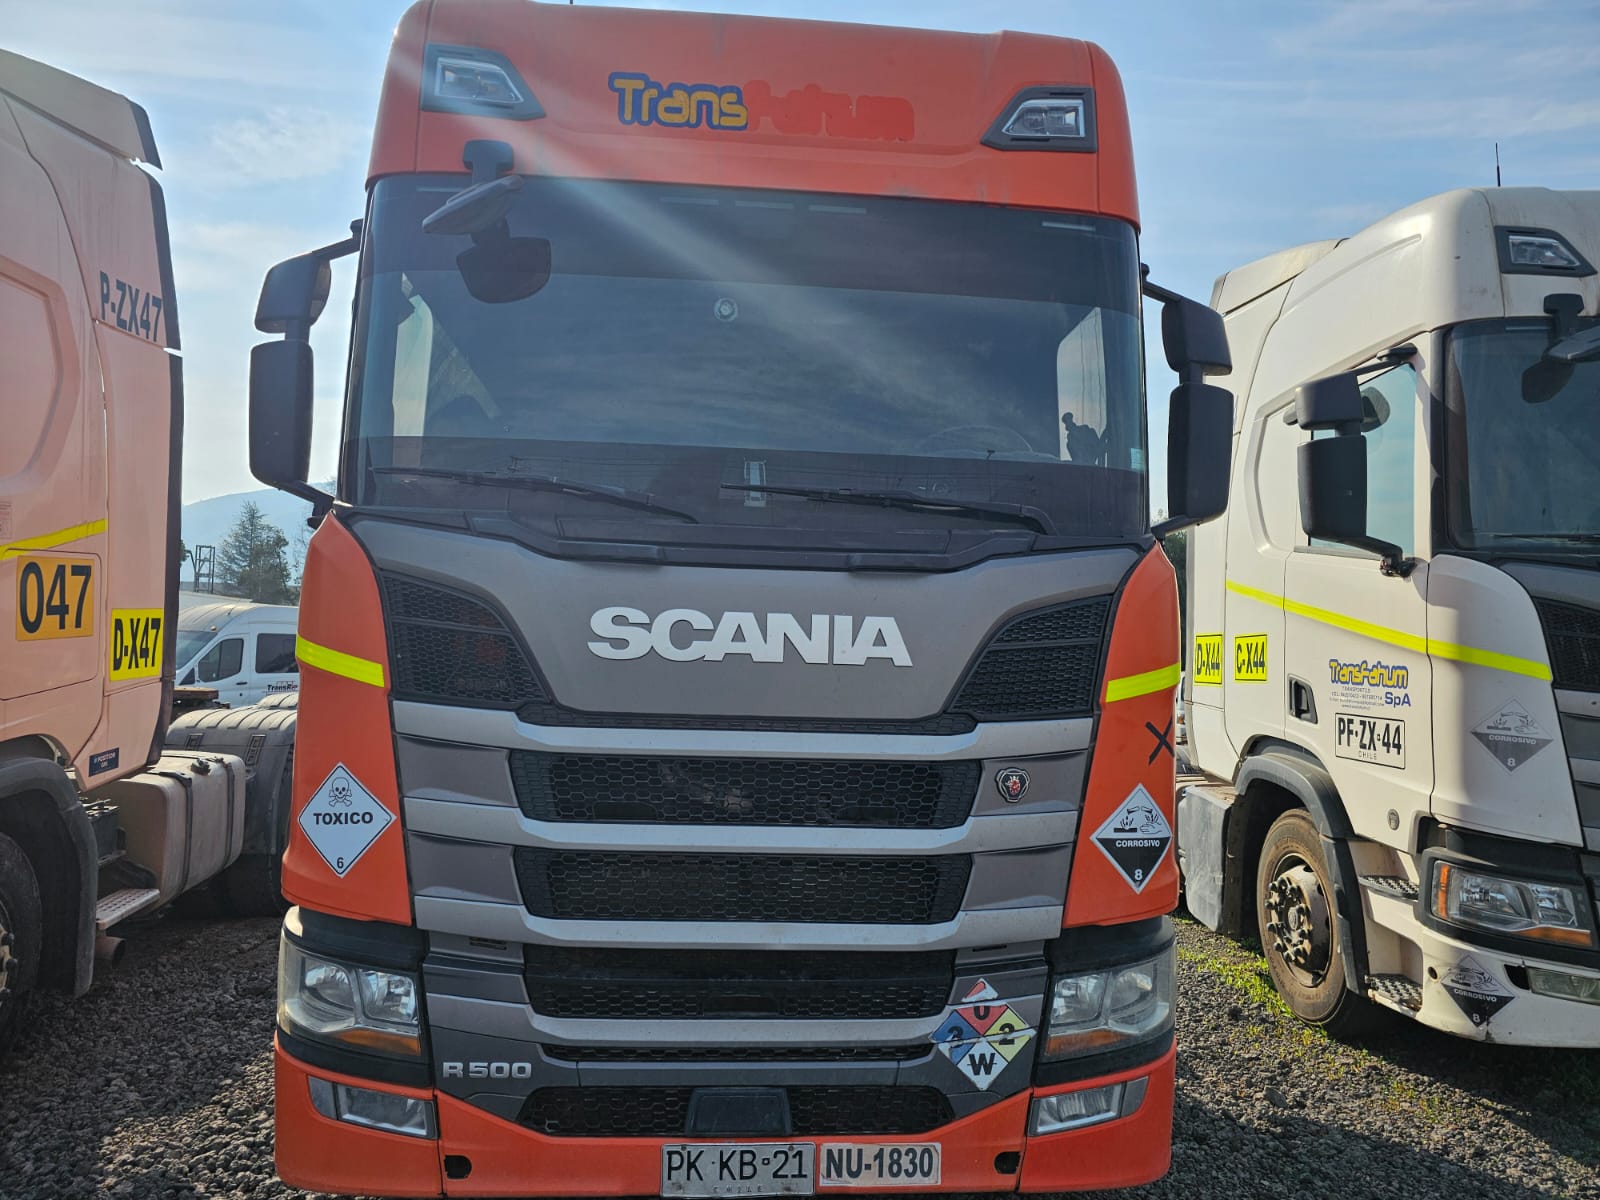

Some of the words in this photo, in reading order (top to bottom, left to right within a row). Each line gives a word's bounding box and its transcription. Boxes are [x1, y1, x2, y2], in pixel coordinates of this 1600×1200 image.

[608, 72, 748, 131] Trans
[100, 269, 162, 342] P-ZX47
[19, 561, 92, 633] 047
[113, 617, 161, 671] D-X47
[586, 605, 914, 668] SCANIA
[1196, 642, 1221, 677] D-X44
[1236, 641, 1266, 674] C-X44
[1385, 692, 1411, 708] SpA
[1488, 734, 1536, 745] CORROSIVO
[313, 812, 374, 825] TOXICO
[1115, 839, 1160, 848] CORROSIVO
[336, 857, 344, 869] 6
[1133, 868, 1143, 880] 8
[1453, 988, 1497, 1003] CORROSIVO
[967, 1052, 997, 1076] W
[825, 1147, 934, 1178] NU-1830
